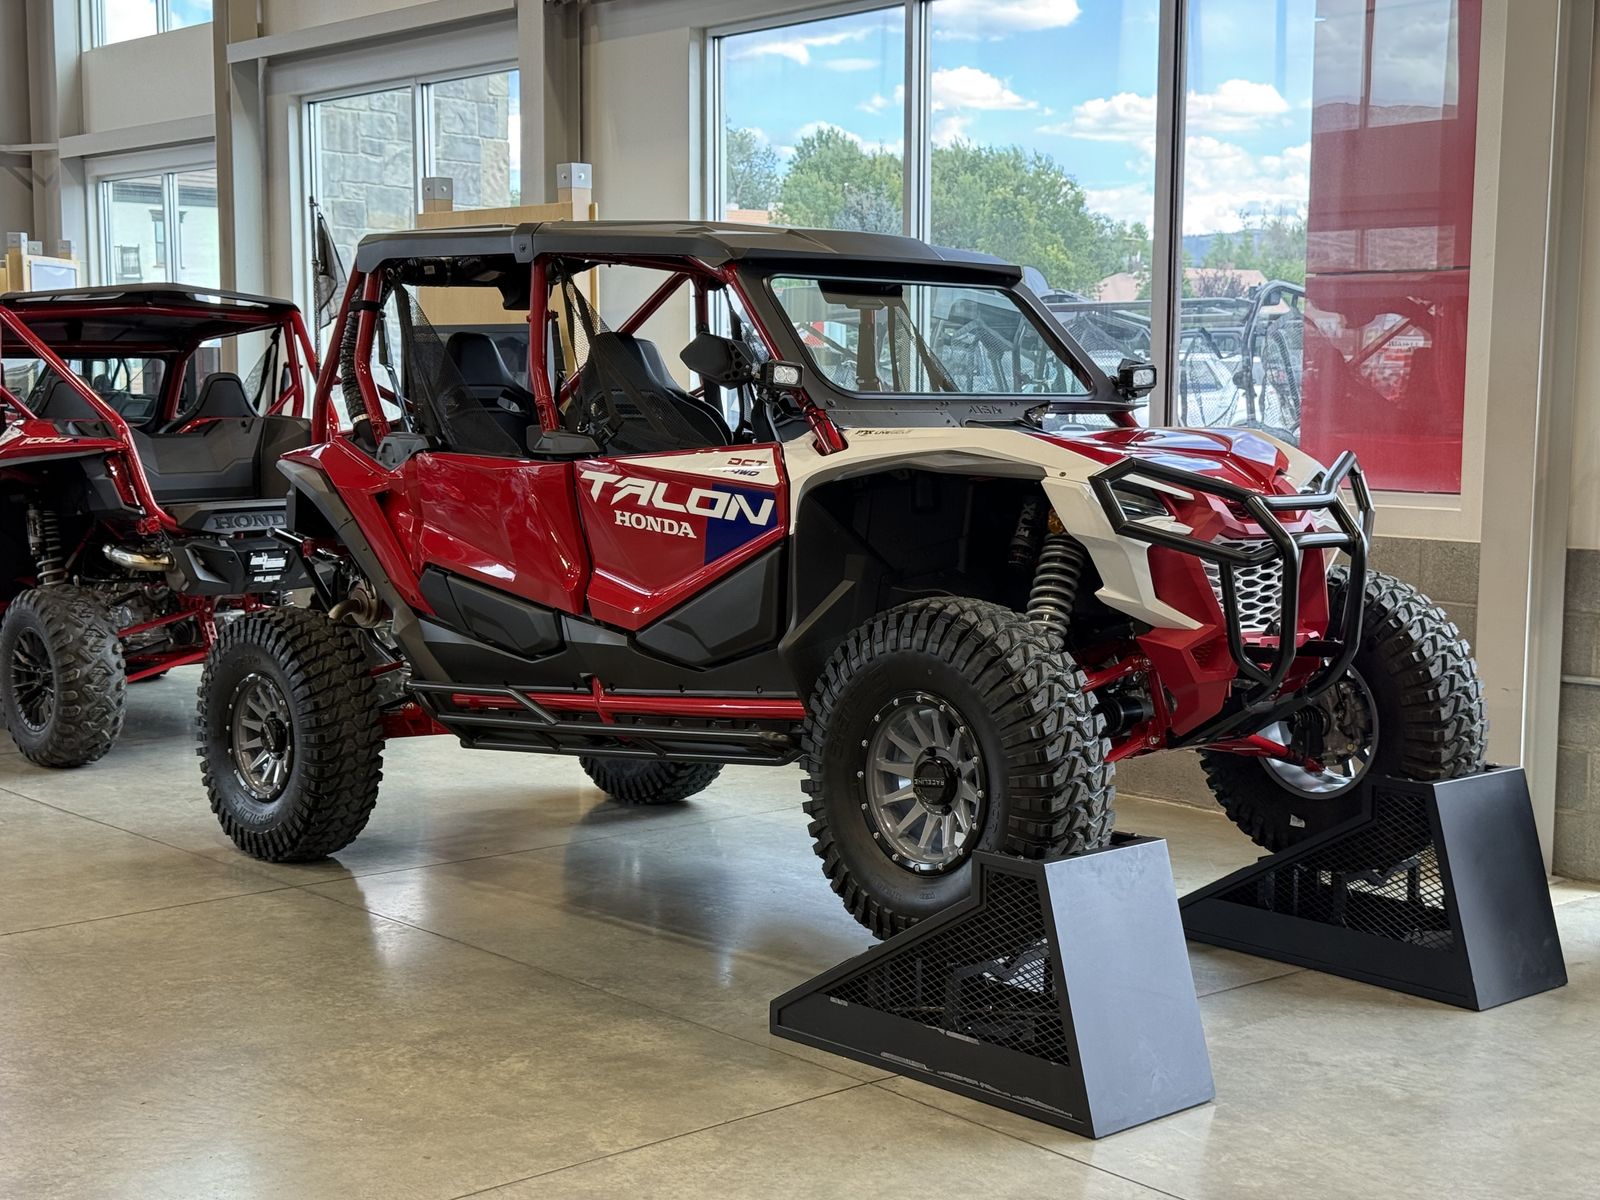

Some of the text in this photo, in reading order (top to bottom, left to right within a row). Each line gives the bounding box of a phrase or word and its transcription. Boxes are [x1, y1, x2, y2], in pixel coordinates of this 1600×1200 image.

[727, 457, 768, 467] DCT
[580, 470, 776, 526] TALON
[214, 513, 286, 529] HOND
[613, 508, 697, 539] HONDA
